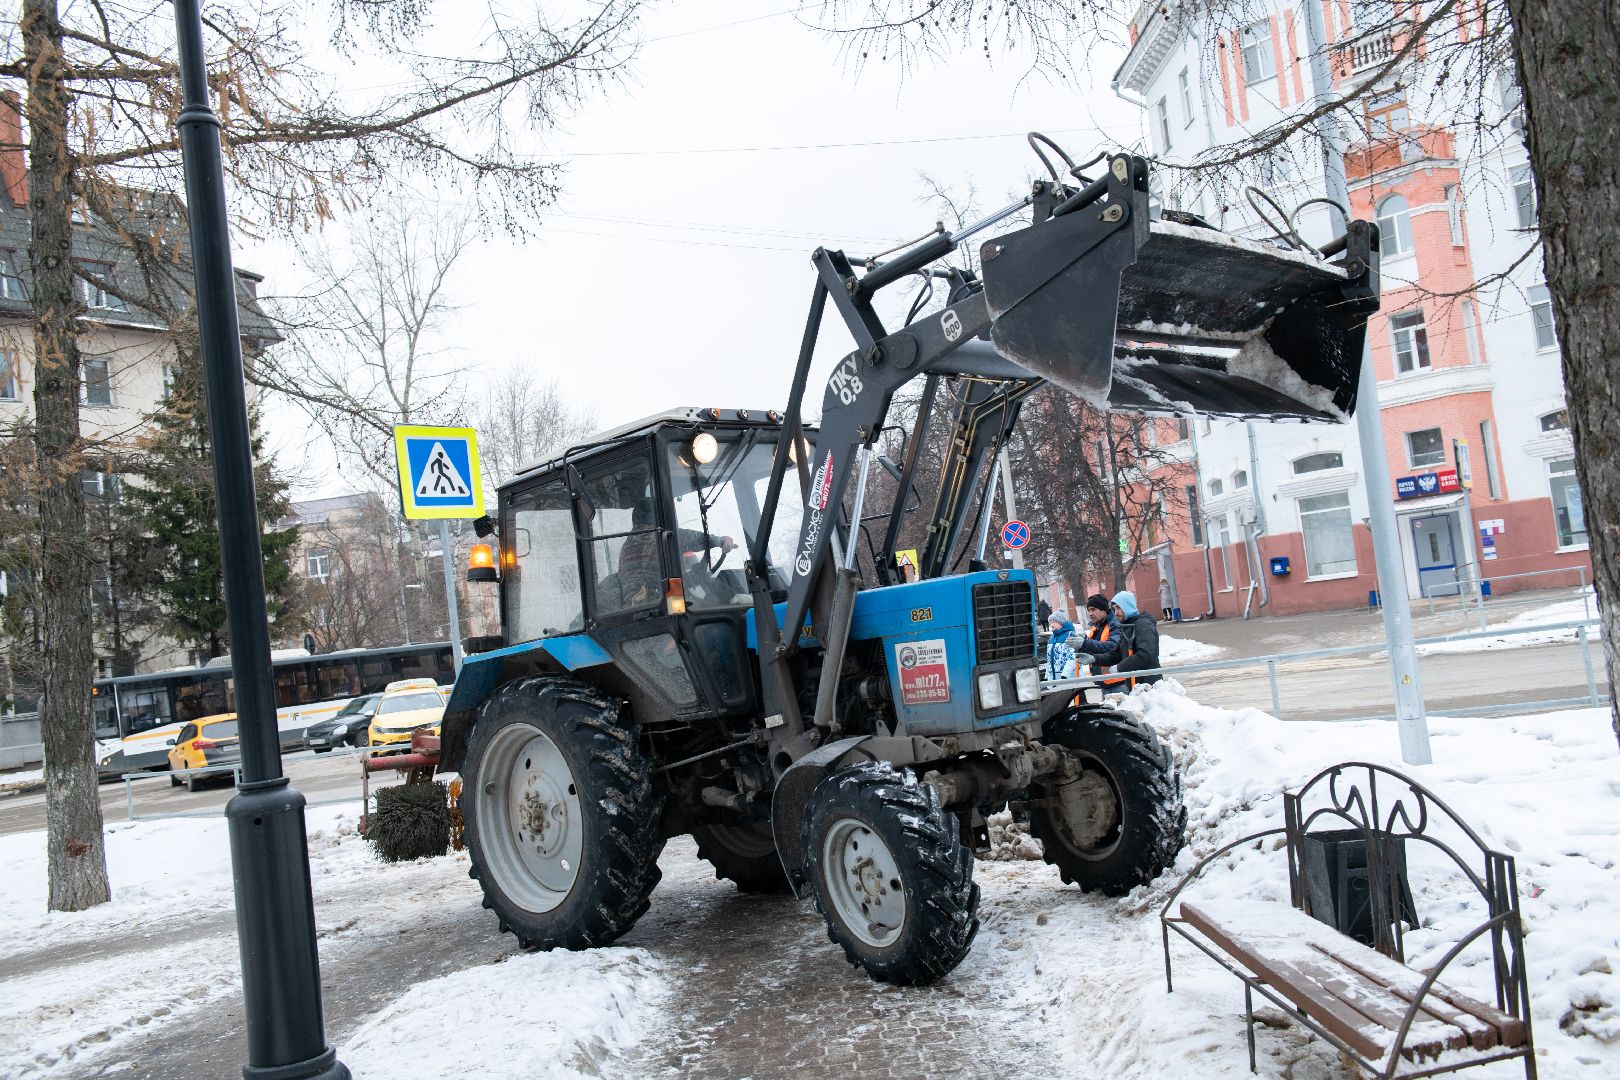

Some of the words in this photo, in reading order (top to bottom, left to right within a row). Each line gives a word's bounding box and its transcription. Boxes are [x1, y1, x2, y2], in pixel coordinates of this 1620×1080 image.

[945, 320, 960, 337] 800
[829, 352, 858, 395] ПКУ
[840, 375, 863, 406] 0,8
